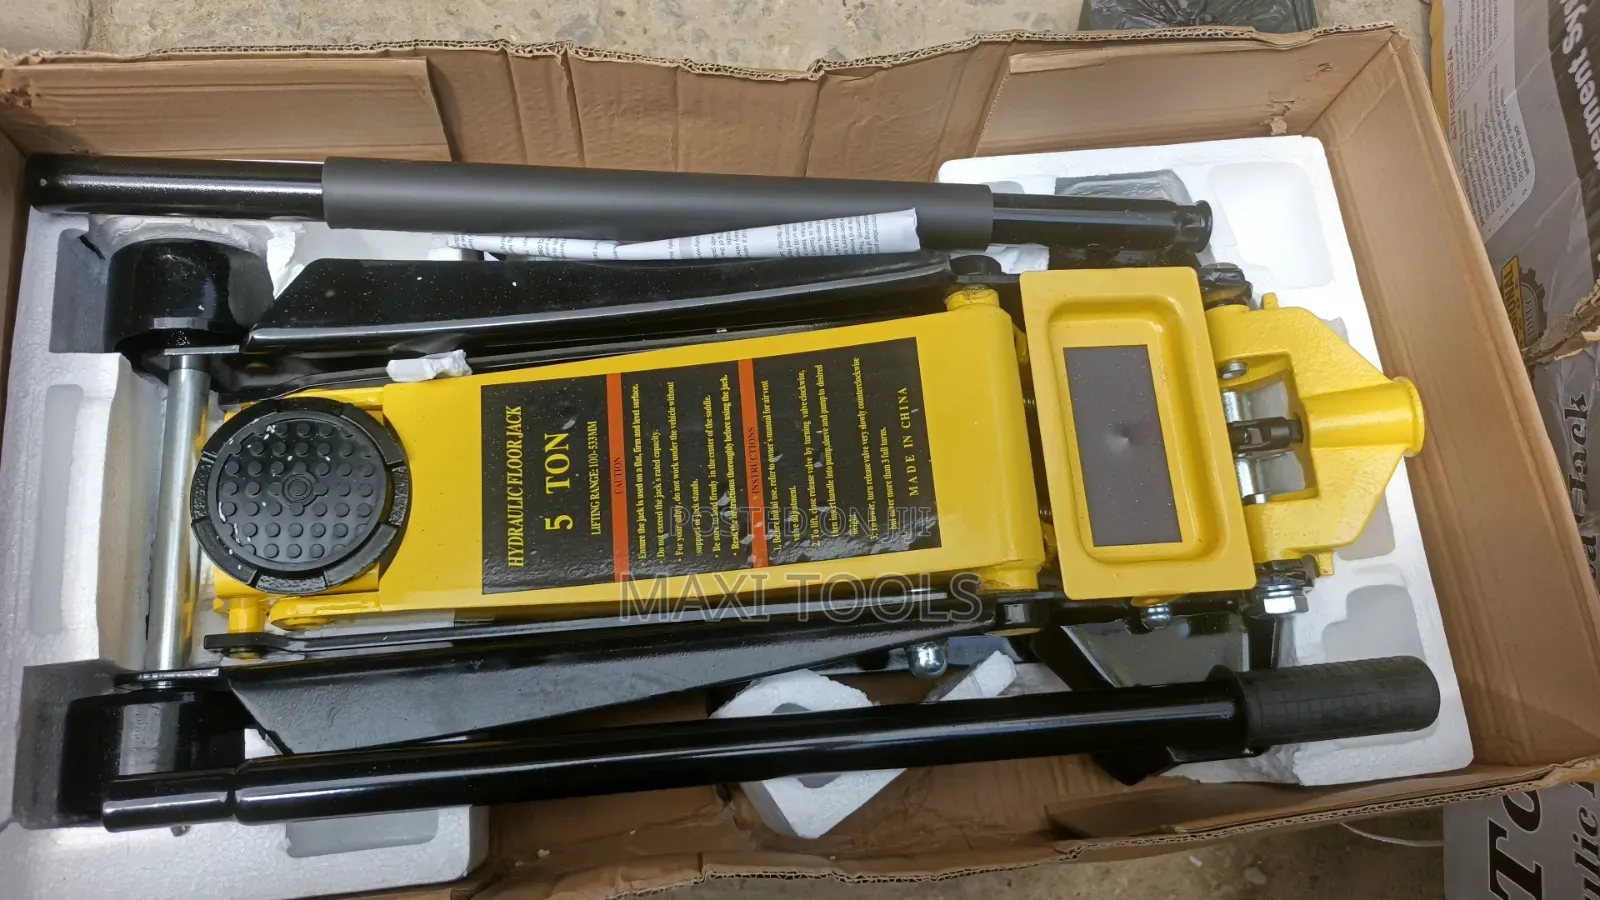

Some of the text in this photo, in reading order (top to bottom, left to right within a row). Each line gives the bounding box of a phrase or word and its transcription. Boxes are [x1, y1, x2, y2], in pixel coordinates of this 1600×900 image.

[1559, 0, 1588, 55] Sys
[720, 375, 730, 390] jack.
[815, 365, 825, 387] desired
[852, 358, 865, 409] counterclockwise
[667, 381, 675, 406] without
[761, 381, 770, 394] vent
[797, 370, 808, 401] clockwise,
[631, 384, 640, 408] surface.
[721, 391, 729, 401] the
[762, 394, 771, 403] air
[820, 395, 829, 414] pump
[703, 395, 712, 417] saddle.
[722, 402, 731, 420] using
[763, 404, 772, 414] for
[800, 402, 809, 418] valve
[632, 410, 640, 424] level
[668, 407, 677, 429] vehicle
[705, 417, 713, 428] the
[764, 415, 773, 437] manual
[819, 415, 829, 427] and
[858, 411, 868, 430] slowly
[633, 425, 641, 437] and
[669, 429, 677, 440] the
[723, 422, 732, 441] before
[802, 421, 812, 444] turning
[860, 427, 870, 445] very
[879, 427, 889, 446] turns.
[633, 438, 642, 452] firm
[651, 430, 661, 458] capacity.
[707, 438, 715, 457] center
[897, 387, 920, 496] MADE IN CHINA
[1563, 393, 1589, 506] Jack
[670, 442, 679, 460] under
[764, 439, 775, 463] owner's
[804, 447, 814, 455] by
[860, 446, 871, 462] valve
[880, 447, 889, 458] full
[652, 460, 662, 476] rated
[724, 443, 736, 478] thoroughly
[747, 427, 759, 494] INSTRUCTIONS
[805, 457, 814, 473] valve
[614, 457, 623, 494] CAUTION
[636, 473, 643, 482] on
[671, 462, 680, 479] work
[768, 471, 777, 486] refer
[825, 466, 834, 479] into
[864, 463, 873, 485] release
[882, 465, 892, 479] than
[506, 406, 524, 567] HYDRAULIC FLOOR JACK
[544, 433, 573, 530] 5 TON
[589, 469, 600, 499] RANGE:
[690, 479, 699, 501] stands.
[709, 481, 718, 500] firmly
[806, 475, 816, 497] release
[885, 480, 894, 497] more
[635, 484, 644, 498] used
[672, 492, 681, 501] do
[727, 479, 737, 518] instructions
[826, 480, 836, 502] handle
[866, 486, 874, 500] turn
[655, 499, 663, 509] the
[789, 485, 801, 541] valve adjustment.
[809, 498, 818, 514] close
[868, 501, 877, 521] lower,
[591, 502, 601, 535] LIFTING
[636, 508, 647, 522] jack
[655, 511, 663, 533] exceed
[810, 516, 819, 528] lift,
[637, 523, 645, 533] the
[675, 525, 684, 542] your
[771, 522, 782, 543] Before
[811, 529, 820, 539] To
[638, 535, 647, 559] Ensure
[656, 534, 664, 546] not
[675, 543, 683, 555] For
[694, 527, 703, 554] support
[713, 543, 721, 551] Be
[657, 547, 665, 557] Do
